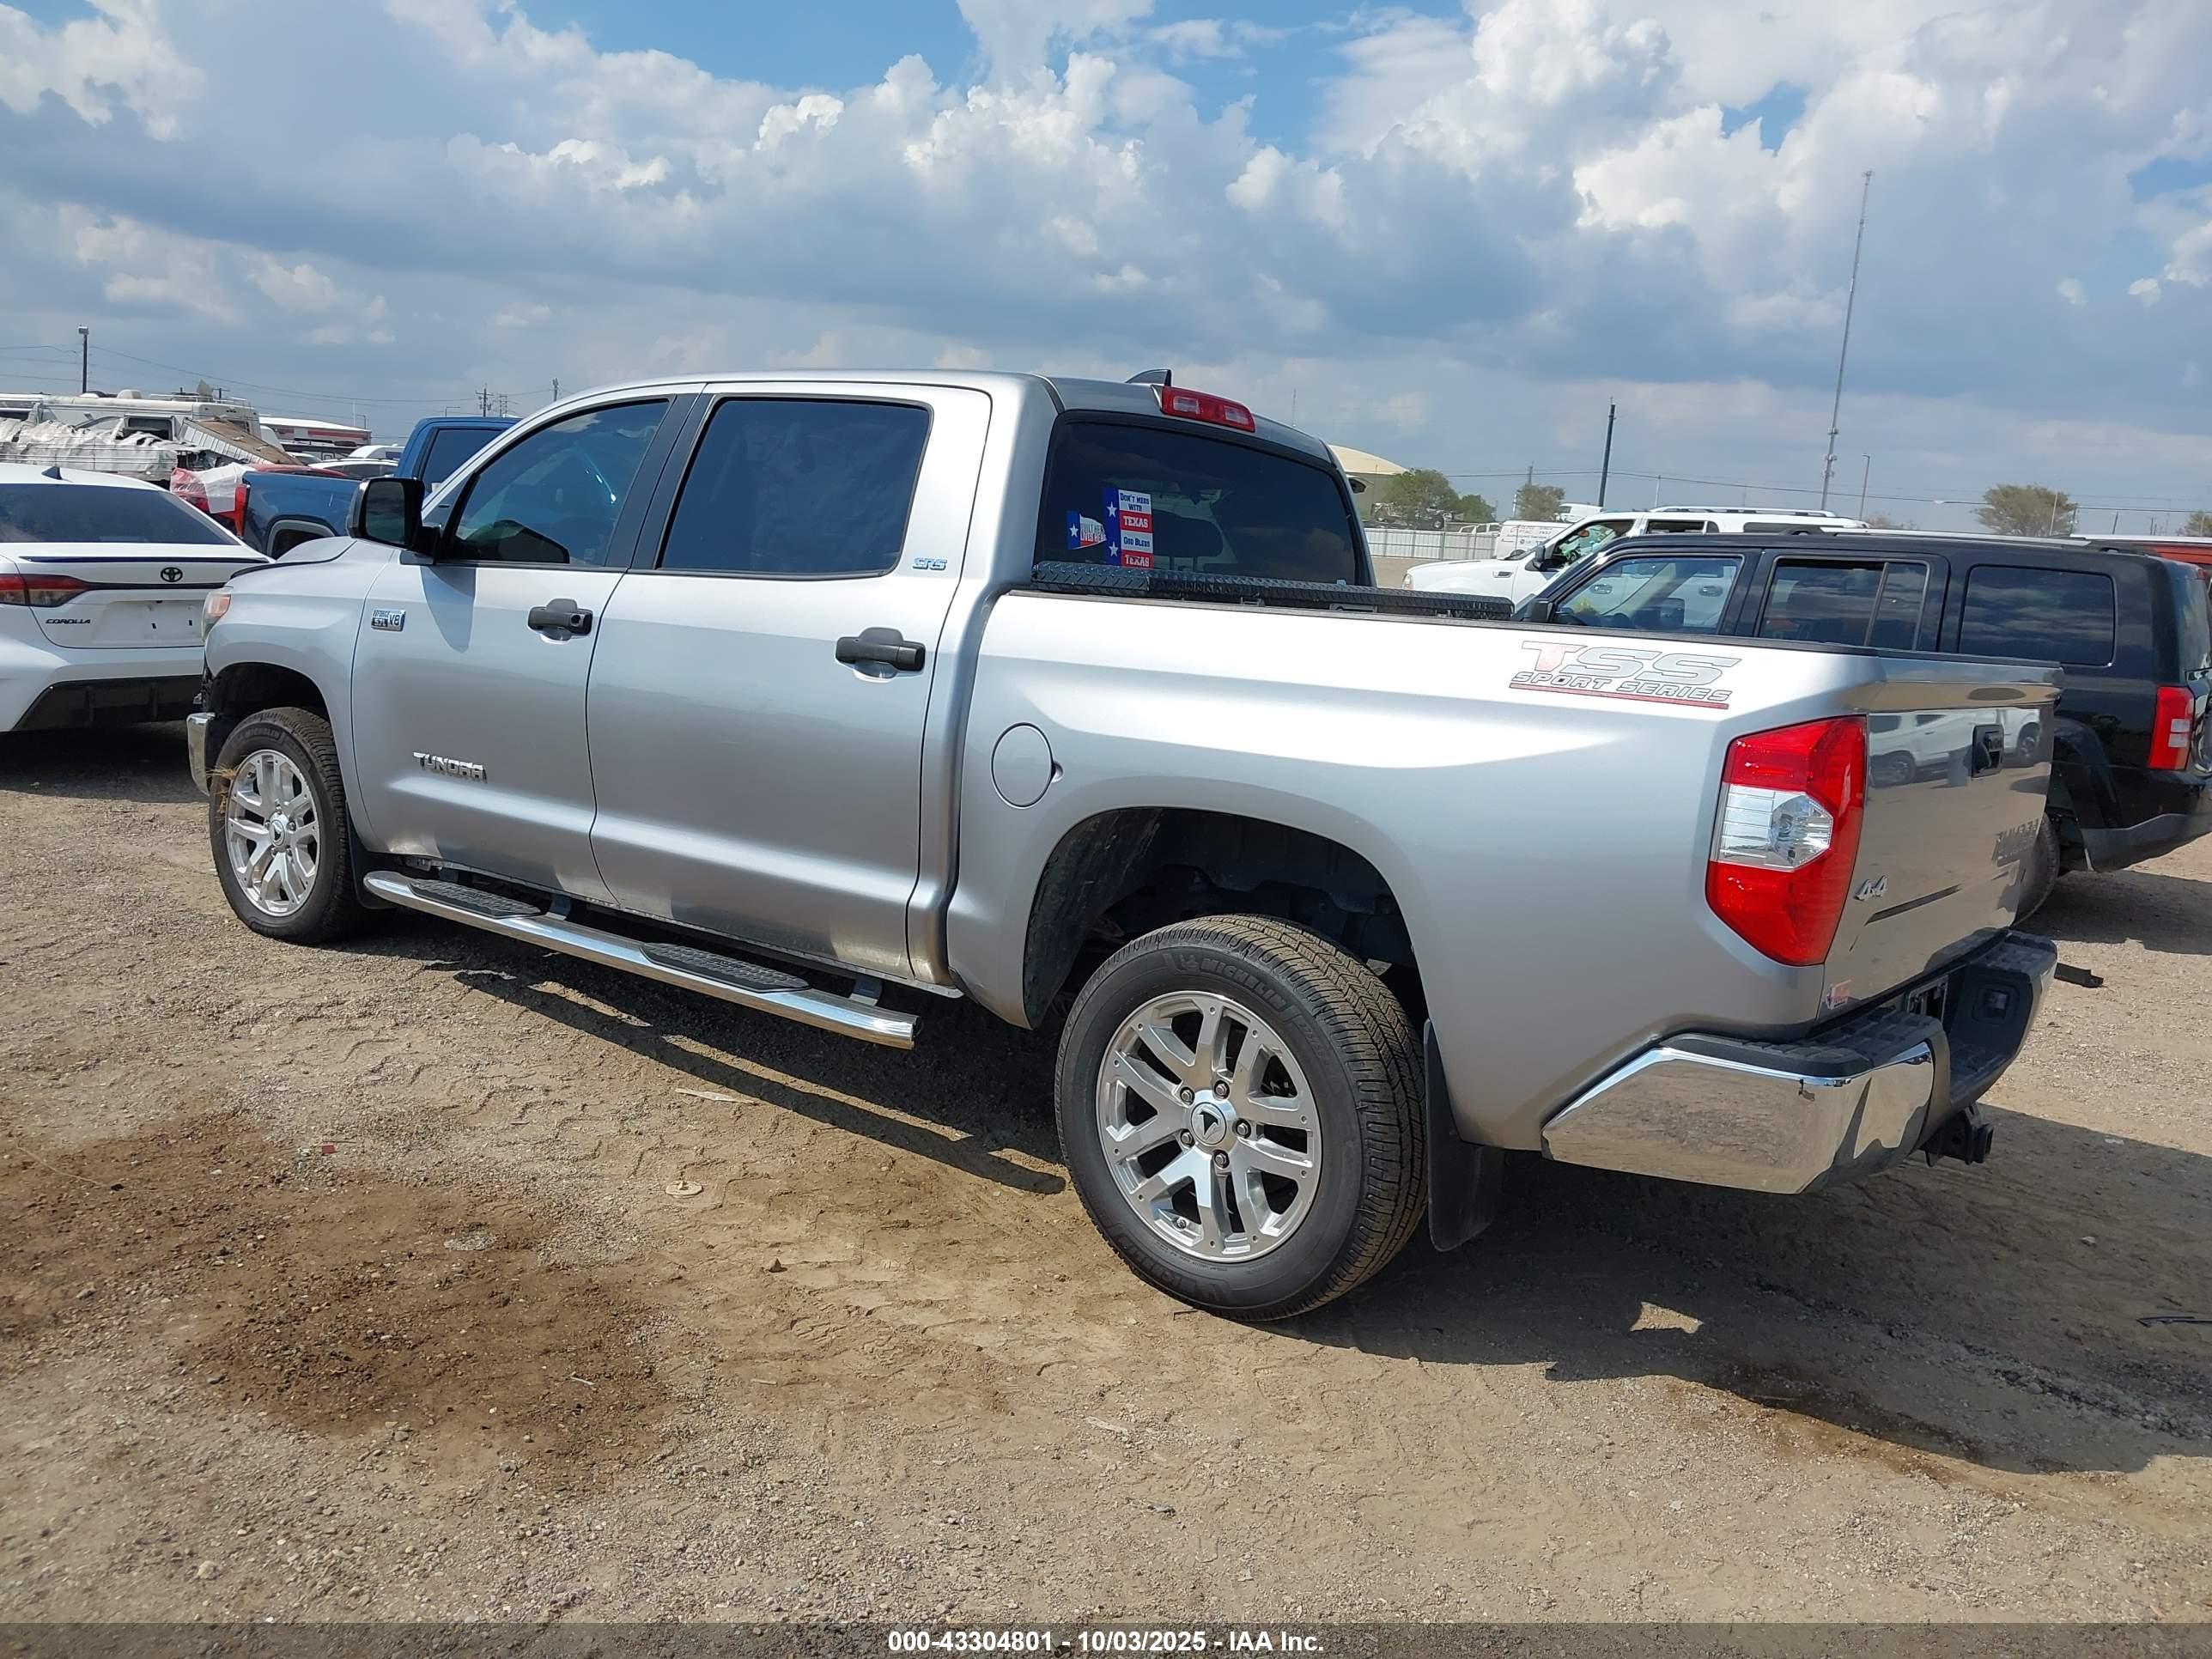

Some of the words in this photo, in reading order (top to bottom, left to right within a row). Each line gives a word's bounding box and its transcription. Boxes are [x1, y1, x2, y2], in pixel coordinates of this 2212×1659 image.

[1123, 515, 1148, 528] TEXAS
[1123, 537, 1134, 545] GOD
[1134, 538, 1151, 548] BLESS
[1124, 554, 1150, 567] TEXAS
[389, 614, 400, 626] V8
[1521, 641, 1742, 686] TSS
[1511, 671, 1613, 690] SPORT
[1616, 681, 1733, 702] SERIES
[412, 751, 487, 783] TUNDRA
[1200, 957, 1287, 1012] MICHELIN
